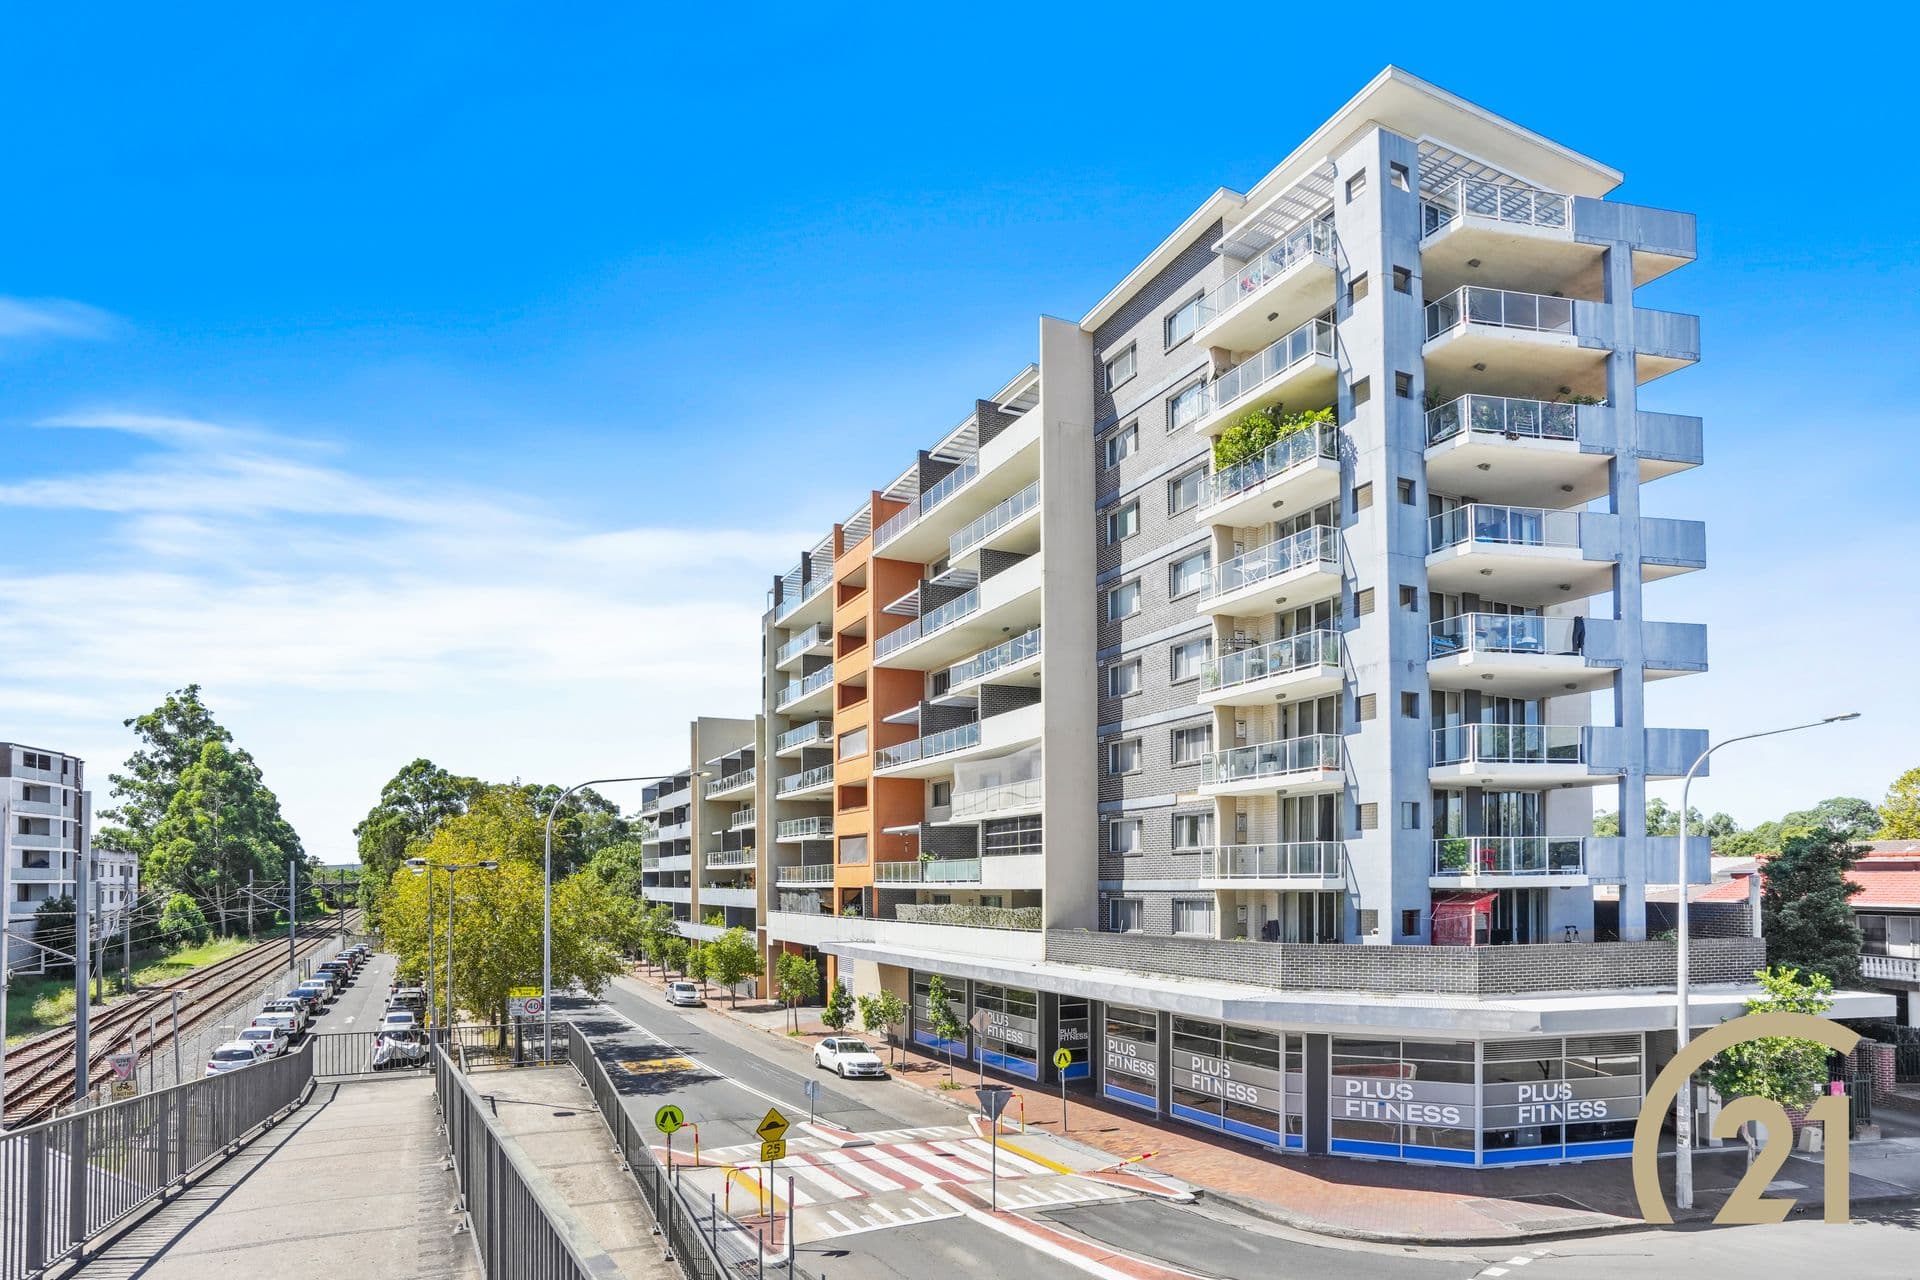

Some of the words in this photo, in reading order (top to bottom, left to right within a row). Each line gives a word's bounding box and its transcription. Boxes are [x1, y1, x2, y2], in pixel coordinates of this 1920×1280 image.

[527, 1002, 539, 1010] 40
[987, 1011, 1009, 1027] PLUS
[987, 1025, 1023, 1044] FITNESS
[1060, 1027, 1078, 1035] PLUS
[1060, 1032, 1089, 1041] FITNESS
[1108, 1039, 1136, 1057] PLUS
[1108, 1053, 1155, 1076] FITNESS
[1191, 1056, 1231, 1079] PLUS
[1191, 1074, 1258, 1104] FITNESS
[1345, 1079, 1414, 1100] PLUS
[1518, 1082, 1572, 1103] PLUS
[1345, 1099, 1460, 1125] FITNESS
[1518, 1100, 1608, 1124] FITNESS
[766, 1143, 781, 1155] 25
